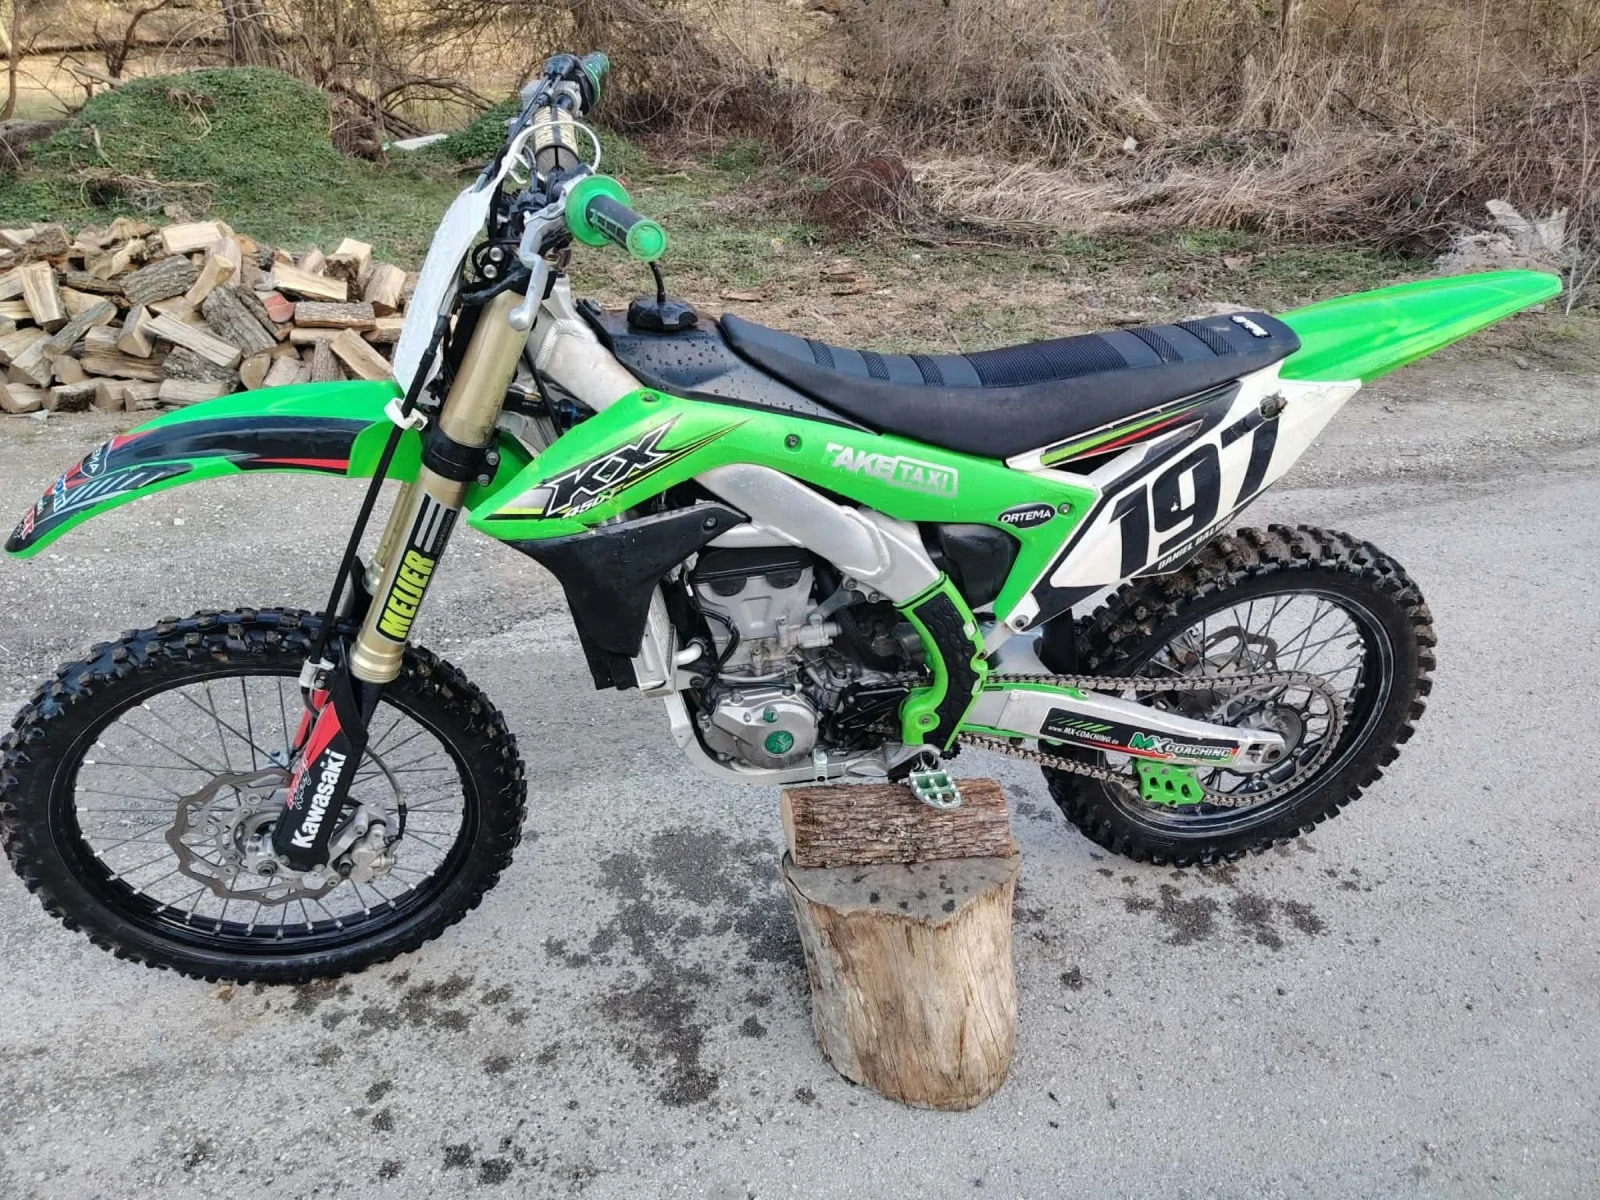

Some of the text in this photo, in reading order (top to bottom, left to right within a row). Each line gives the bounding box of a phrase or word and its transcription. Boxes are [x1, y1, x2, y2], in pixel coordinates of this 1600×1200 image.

[543, 415, 679, 518] KX
[823, 442, 950, 490] FAKE TAXI
[1109, 407, 1279, 579] 197
[1001, 508, 1051, 524] ORTEMA
[379, 549, 436, 639] MEIJER
[1128, 732, 1231, 759] MX COACHING
[291, 748, 347, 849] Kawasaki
